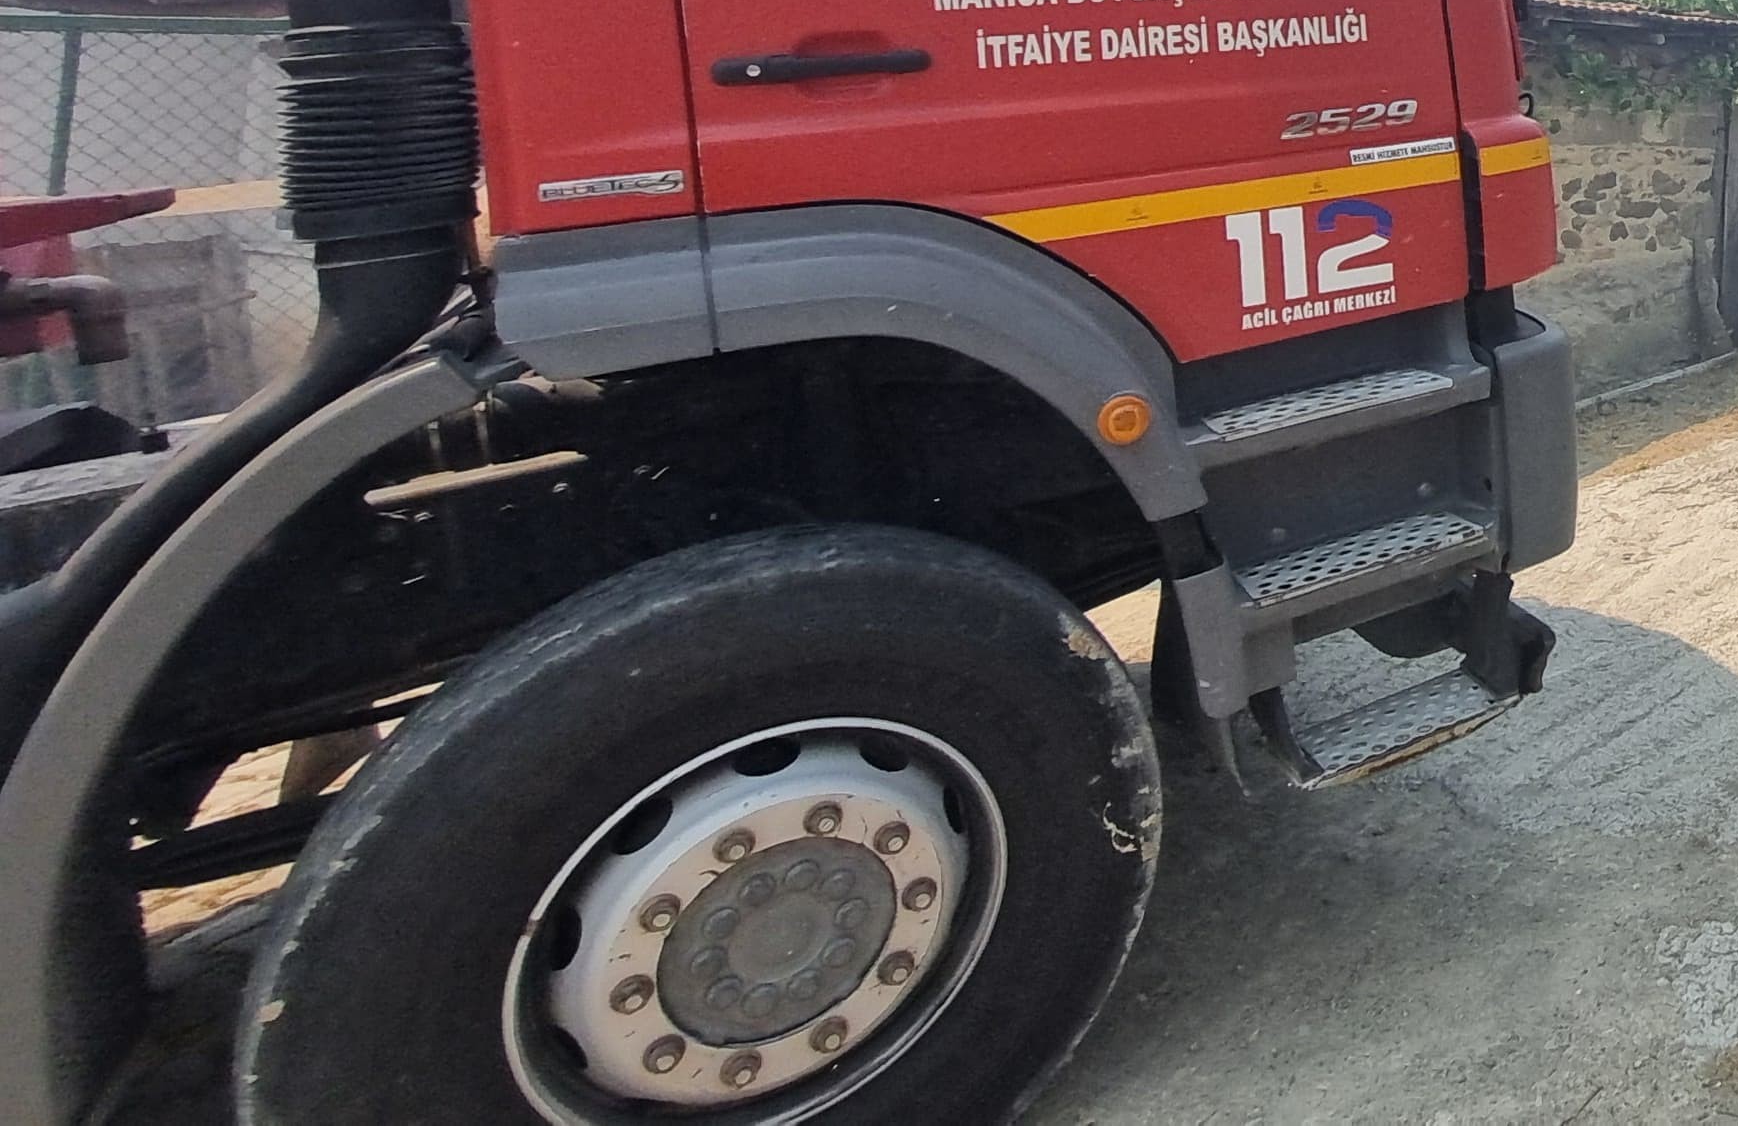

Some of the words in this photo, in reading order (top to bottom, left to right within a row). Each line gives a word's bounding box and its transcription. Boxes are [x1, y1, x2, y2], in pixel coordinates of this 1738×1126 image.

[976, 24, 1091, 69] İTFAİYE
[1101, 16, 1210, 59] DAİRESİ
[1217, 8, 1368, 58] BAŞKANLIĞI
[1280, 99, 1418, 140] 2529
[1226, 200, 1394, 307] 112
[1241, 307, 1279, 331] ACİL
[1281, 298, 1330, 326] ÇAĞRI
[1333, 285, 1396, 314] MERKEZİ
